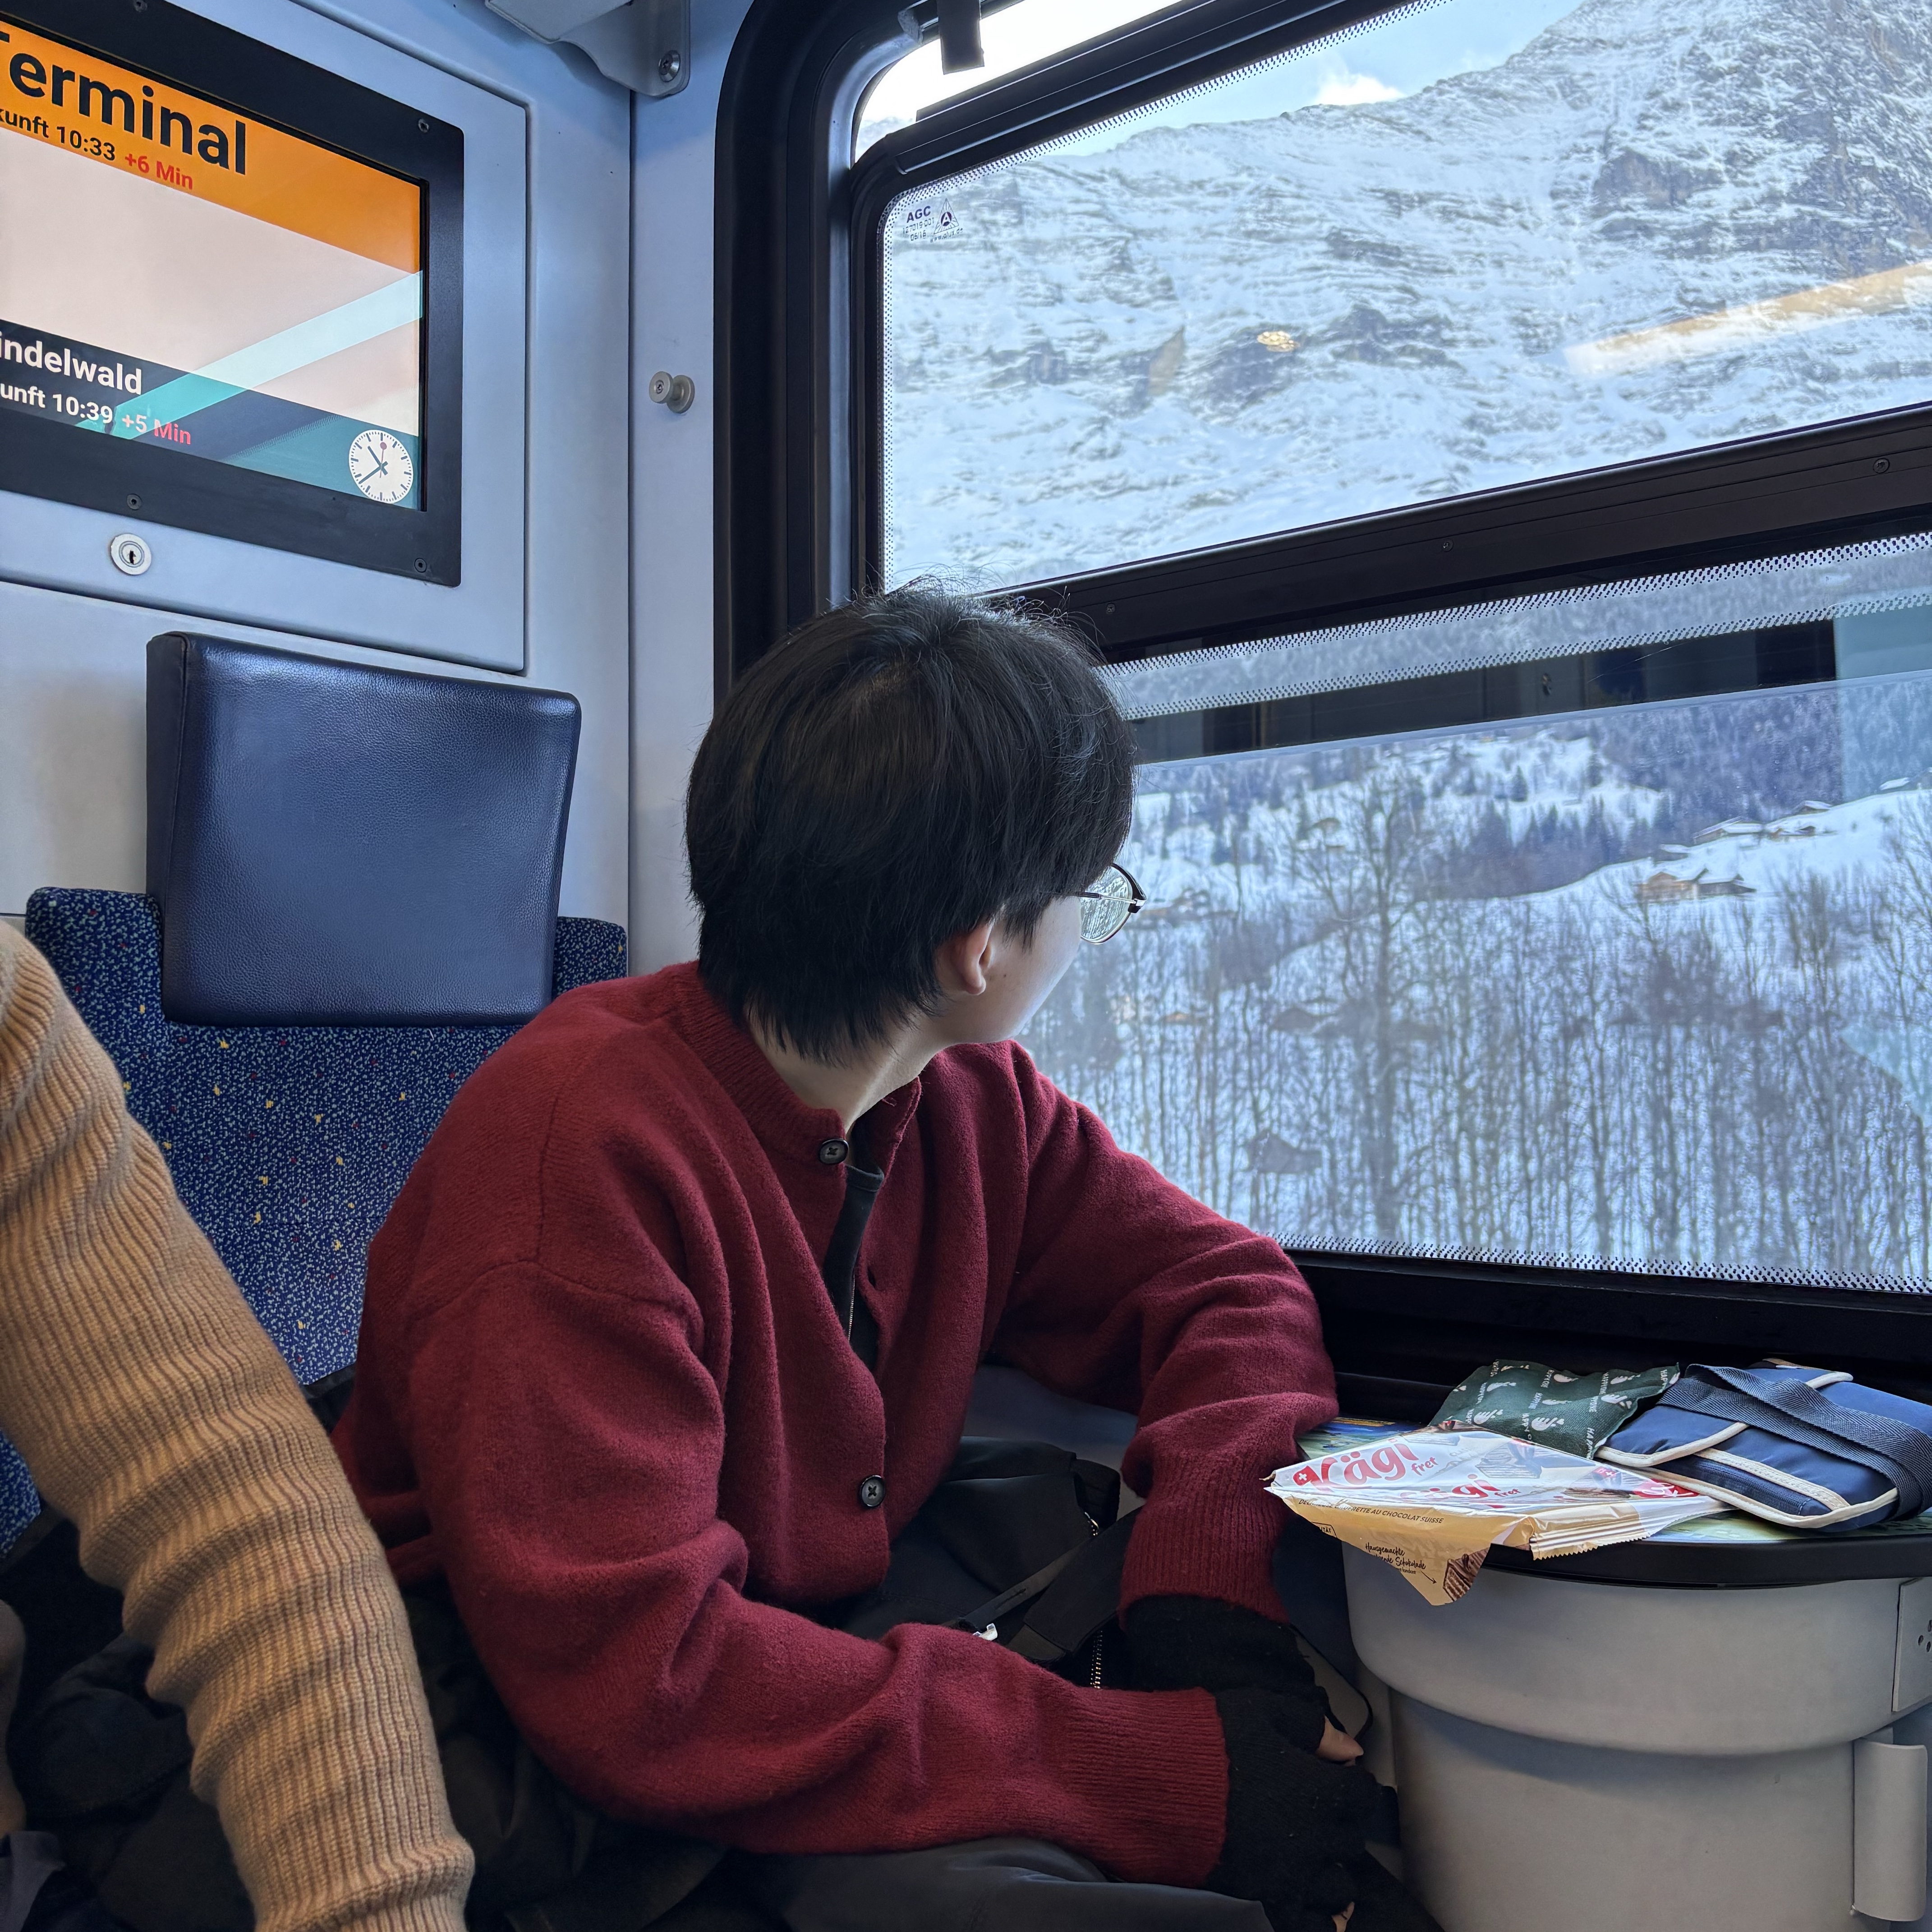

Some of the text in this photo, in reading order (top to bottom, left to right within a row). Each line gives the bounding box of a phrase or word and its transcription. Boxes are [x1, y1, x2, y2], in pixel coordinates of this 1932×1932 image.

[57, 126, 115, 161] 10:33
[124, 153, 149, 173] +6
[156, 161, 193, 190] Min
[906, 206, 931, 223] AGC
[0, 331, 142, 395] ndelwald
[53, 394, 113, 424] 10:39
[122, 414, 147, 433] +5
[154, 419, 191, 445] Min
[1293, 1438, 1419, 1492] Kägi
[1411, 1457, 1439, 1476] fret
[1382, 1510, 1421, 1521] CHOCOLAT
[1395, 1556, 1426, 1569] Schokolade
